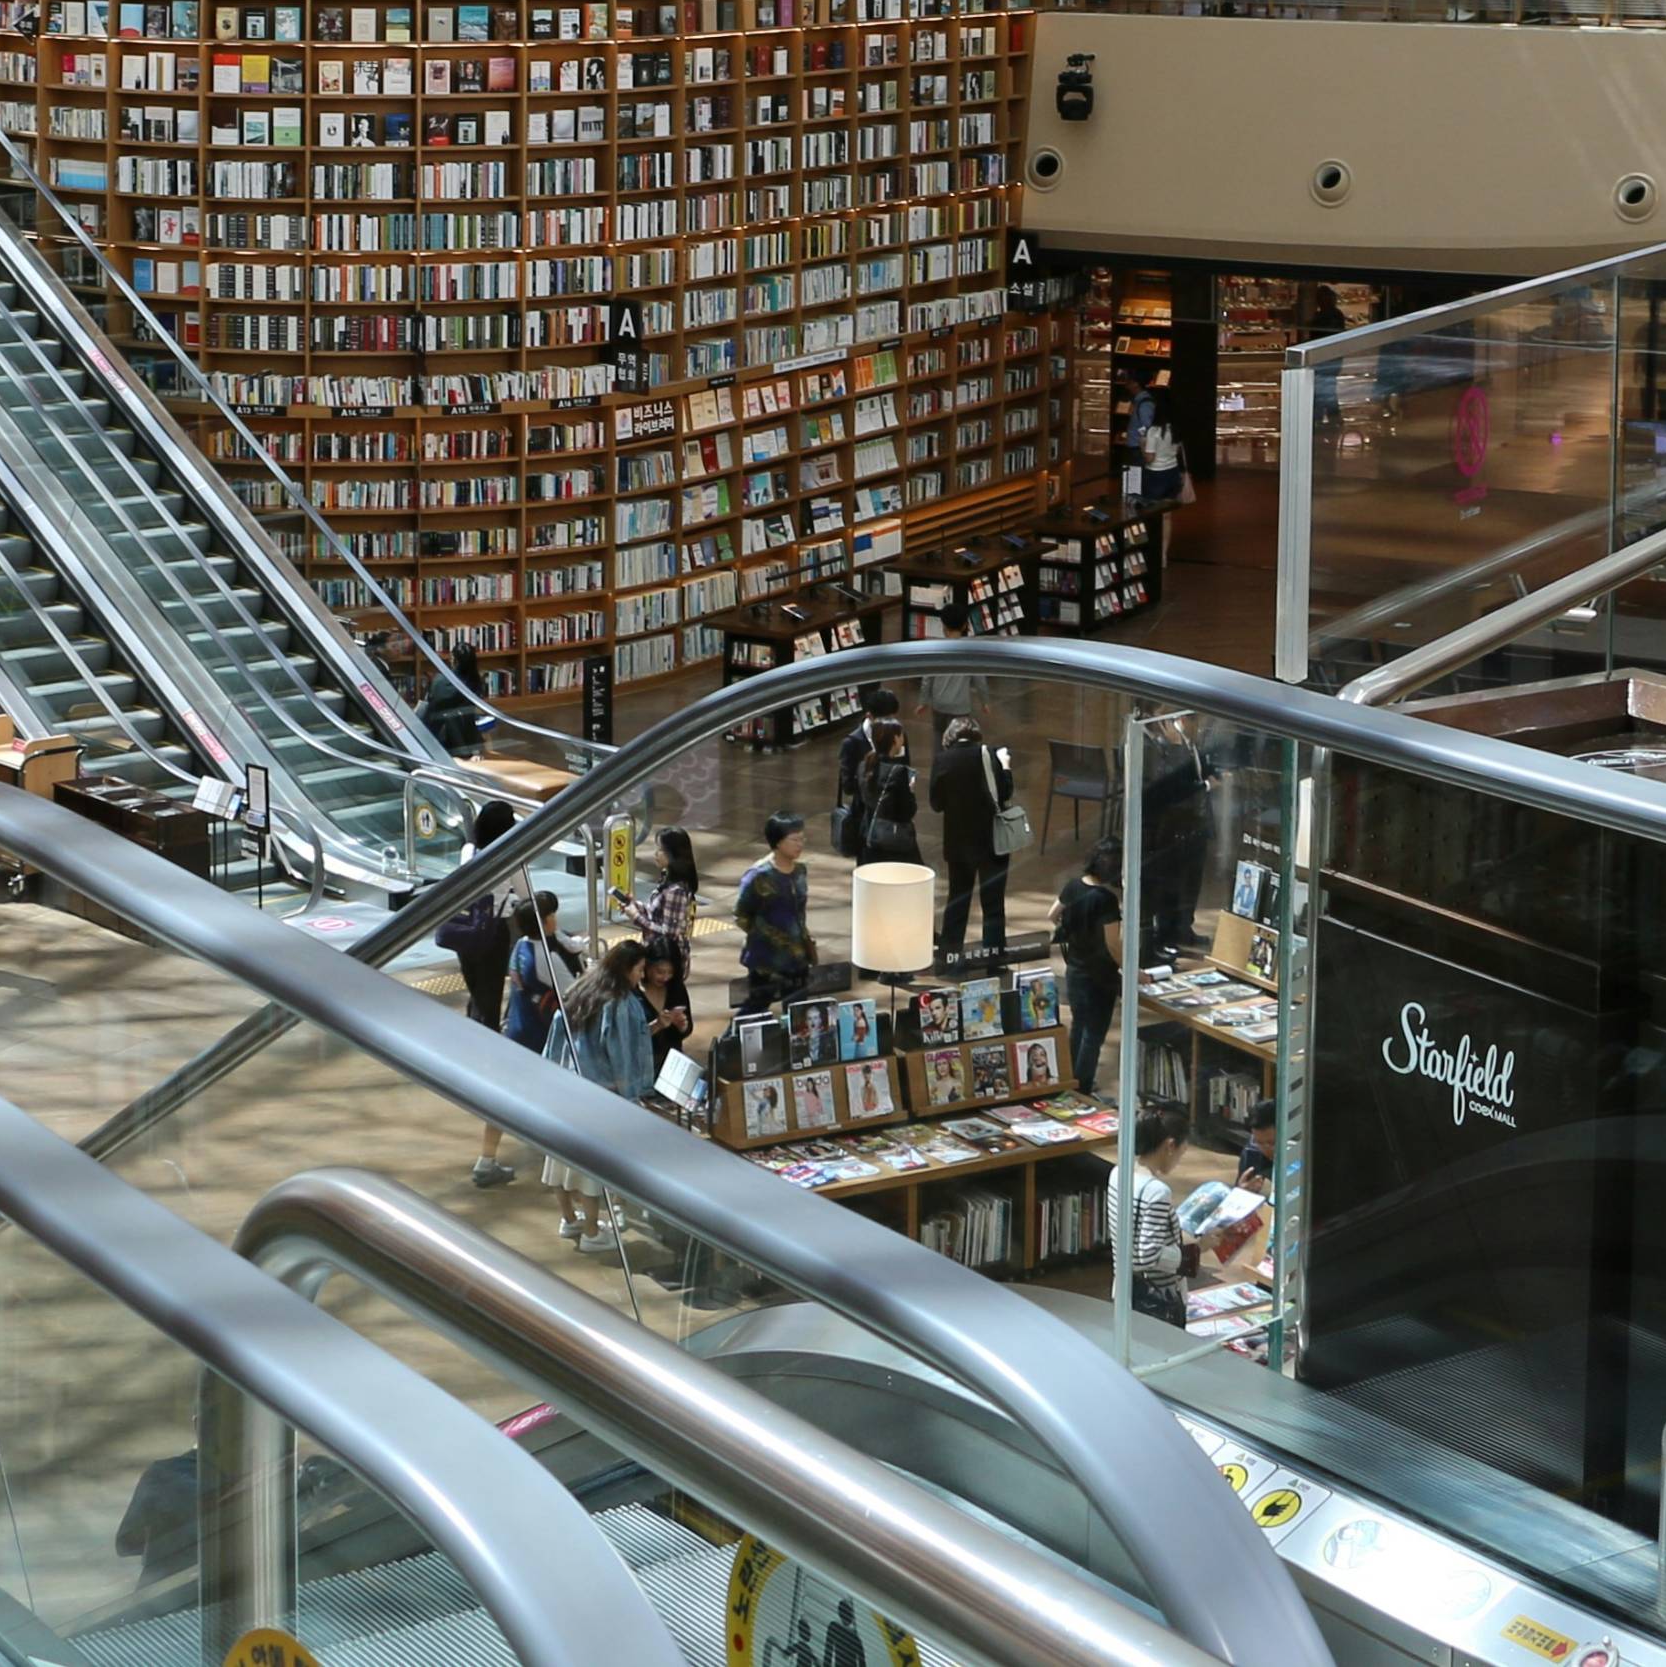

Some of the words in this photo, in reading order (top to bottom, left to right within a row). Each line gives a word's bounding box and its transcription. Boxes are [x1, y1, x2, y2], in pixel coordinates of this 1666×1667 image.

[1013, 239, 1032, 265] A
[618, 308, 636, 339] A
[633, 400, 675, 421] 비즈니스
[1382, 1002, 1515, 1125] Starfield
